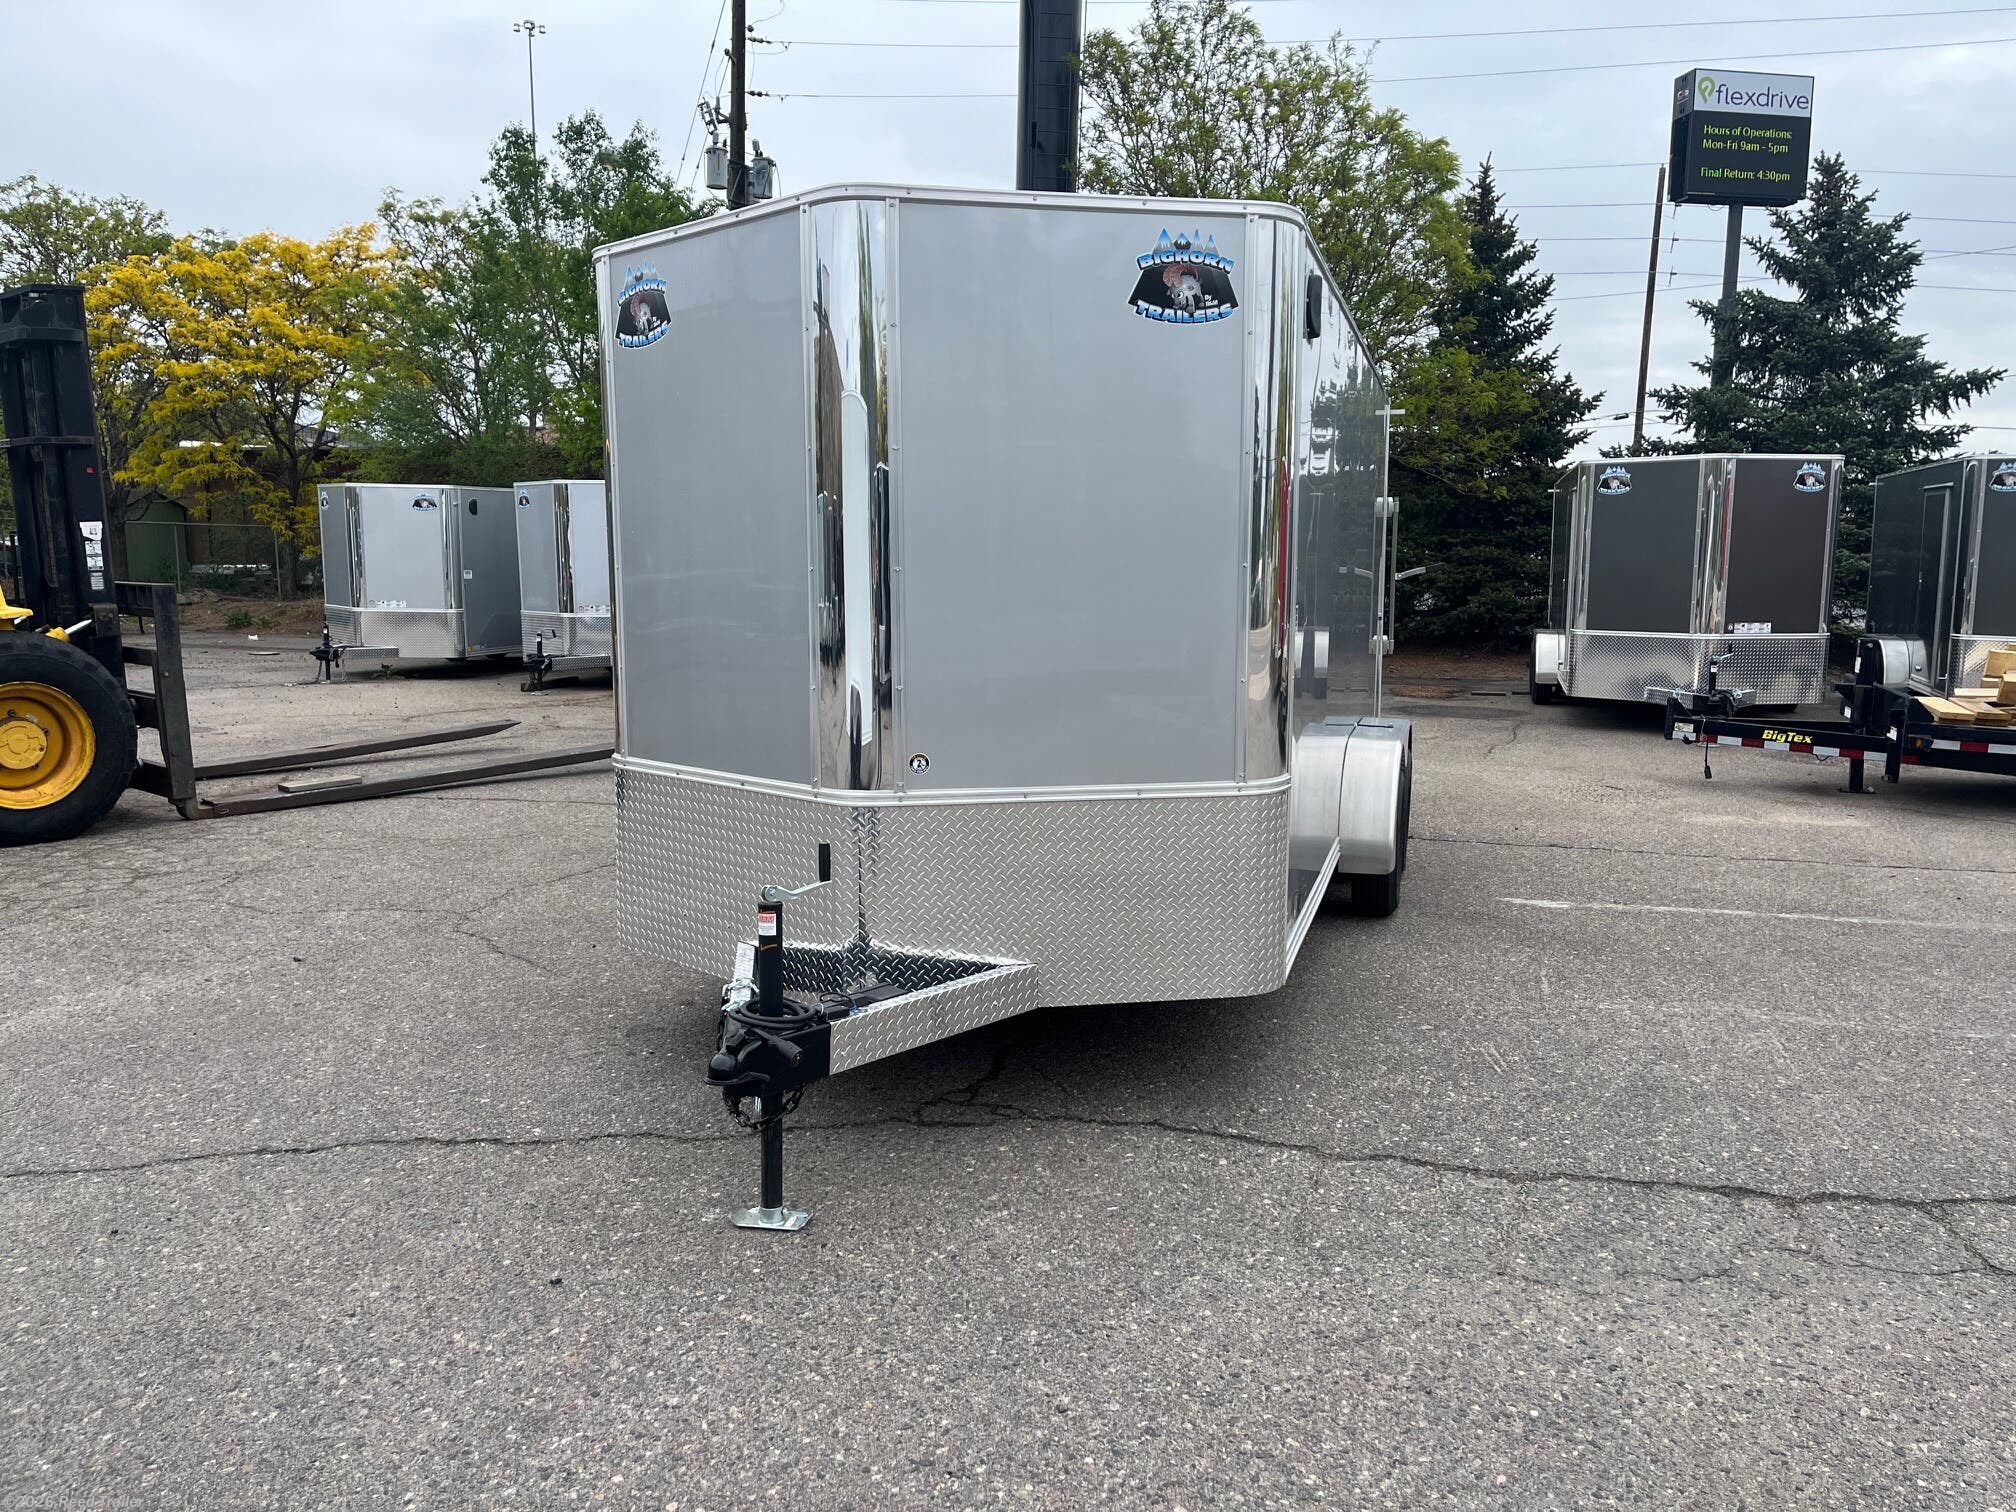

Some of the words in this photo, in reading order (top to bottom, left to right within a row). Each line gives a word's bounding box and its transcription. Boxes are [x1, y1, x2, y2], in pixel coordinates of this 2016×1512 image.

[1715, 84, 1809, 110] flexdrive
[1703, 125, 1730, 136] Hours
[1732, 126, 1741, 136] of
[1702, 139, 1738, 150] Mon-Fri
[1740, 142, 1760, 151] 9am
[1768, 142, 1788, 154] 5pm
[1700, 167, 1722, 178] Final
[1724, 168, 1755, 180] Return:
[1757, 170, 1790, 182] 4:30pm
[1137, 249, 1235, 274] BIGHORN
[617, 278, 667, 306] BIGHORN
[1135, 299, 1233, 324] TRAILERS
[1762, 729, 1812, 744] BigTex
